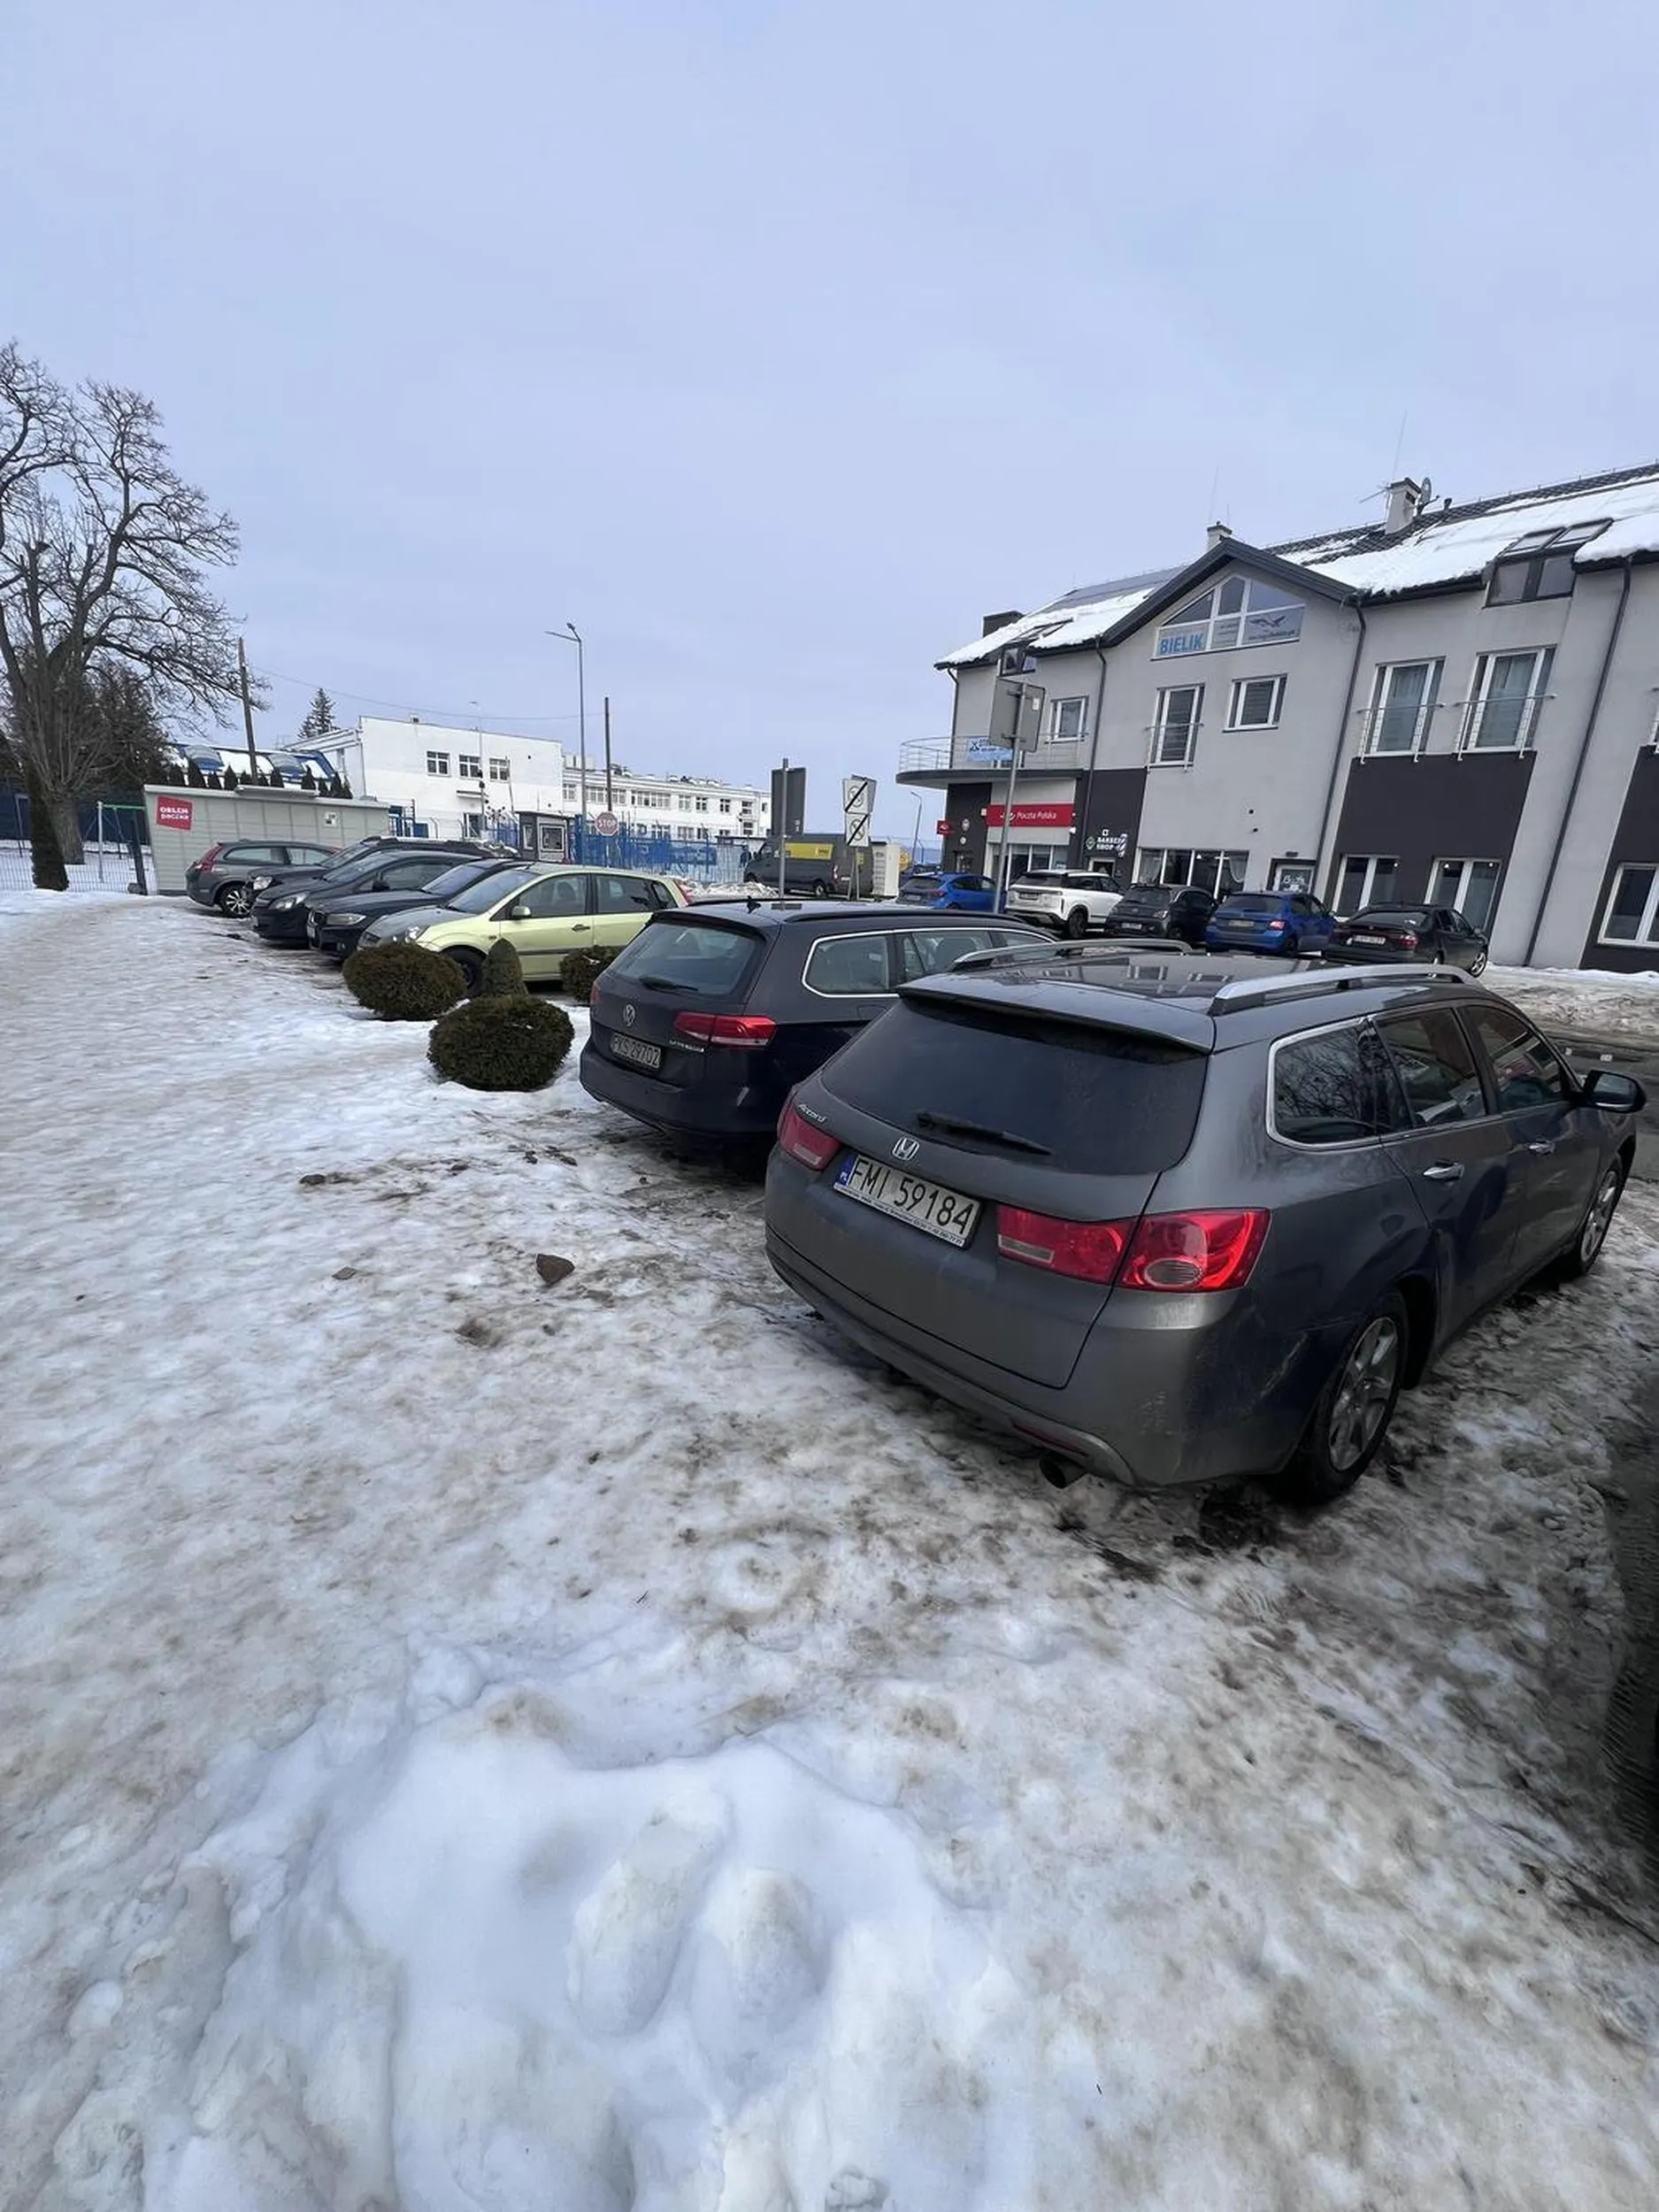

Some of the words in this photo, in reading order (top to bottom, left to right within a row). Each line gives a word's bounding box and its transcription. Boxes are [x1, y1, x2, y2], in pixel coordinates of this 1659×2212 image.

[1160, 633, 1204, 655] BIELIK
[597, 818, 617, 828] STOP
[1037, 810, 1057, 819] Polska
[798, 1103, 826, 1122] Accord
[847, 1157, 891, 1199] FMI
[894, 1176, 974, 1235] 59184
